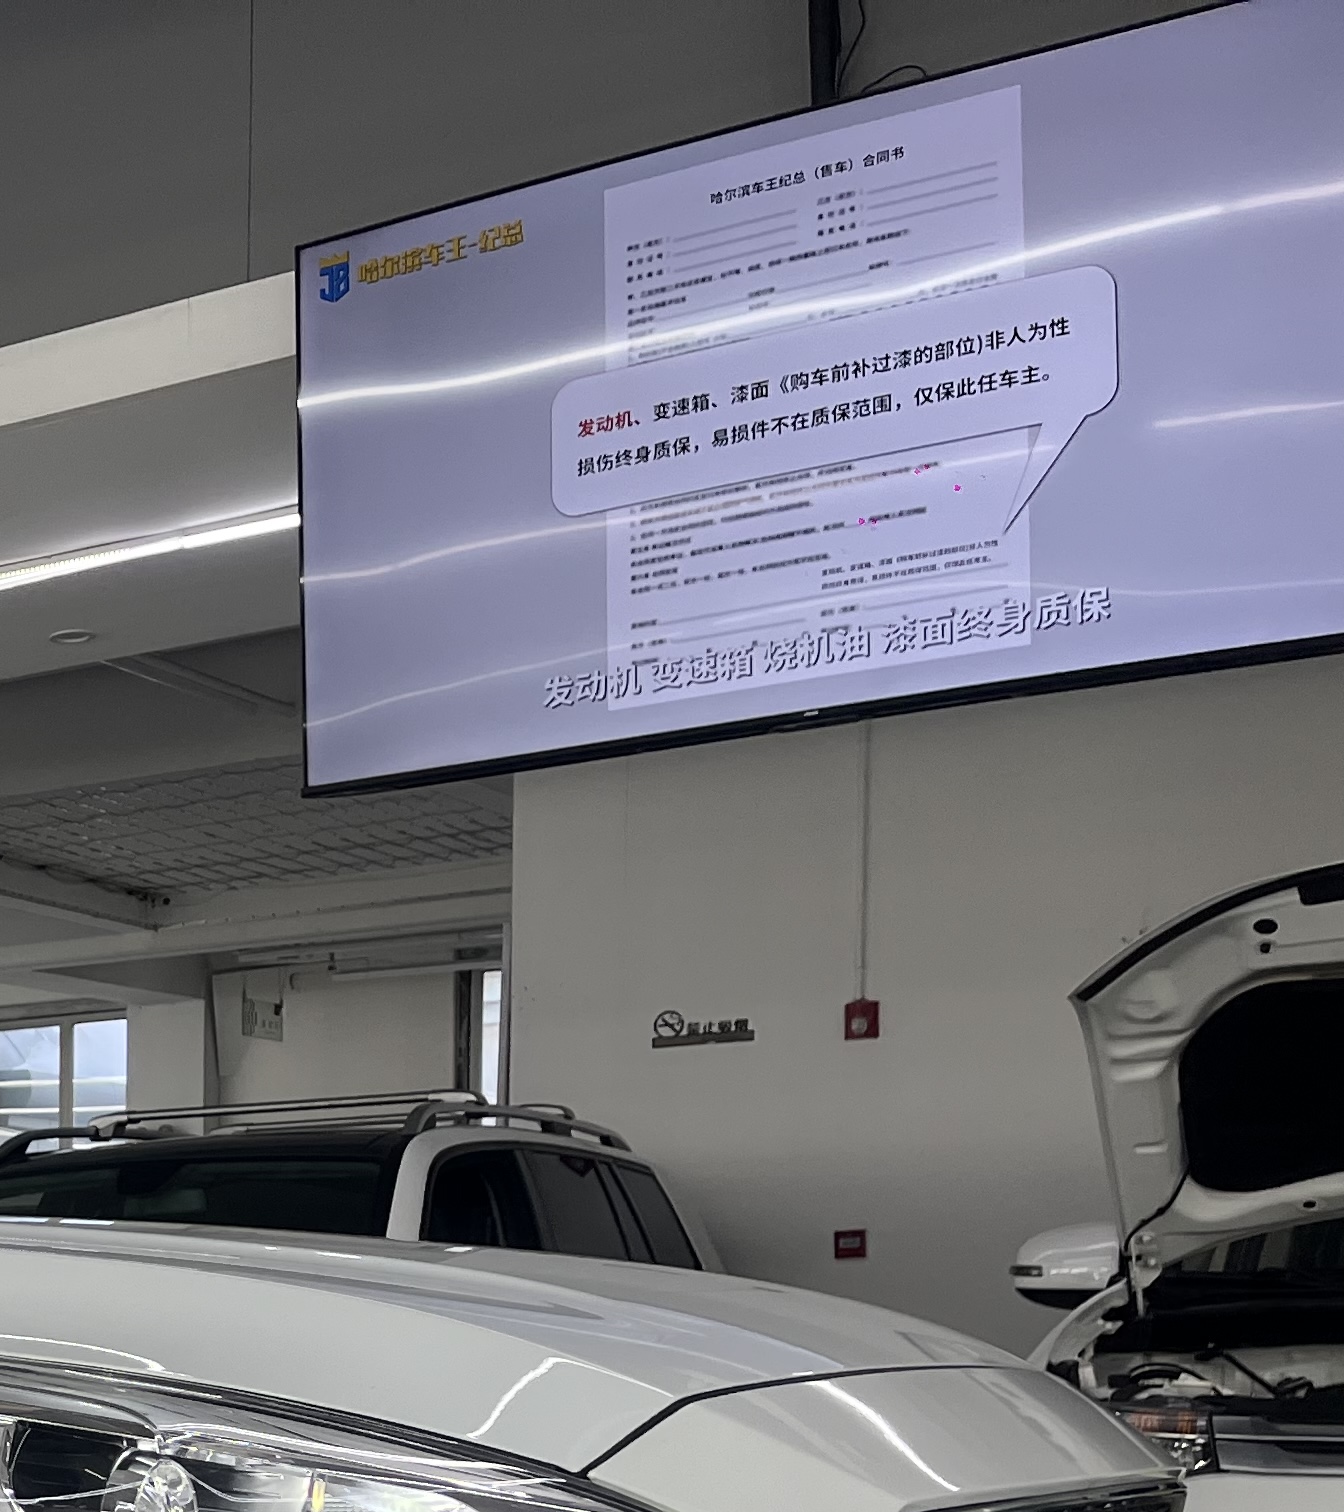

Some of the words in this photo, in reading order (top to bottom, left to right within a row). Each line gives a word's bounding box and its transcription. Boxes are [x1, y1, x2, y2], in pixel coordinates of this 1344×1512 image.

[543, 664, 642, 709] 发动机
[652, 647, 756, 693] 变速箱
[763, 629, 870, 674] 烧机油
[881, 586, 1112, 655] 漆面终身质保
